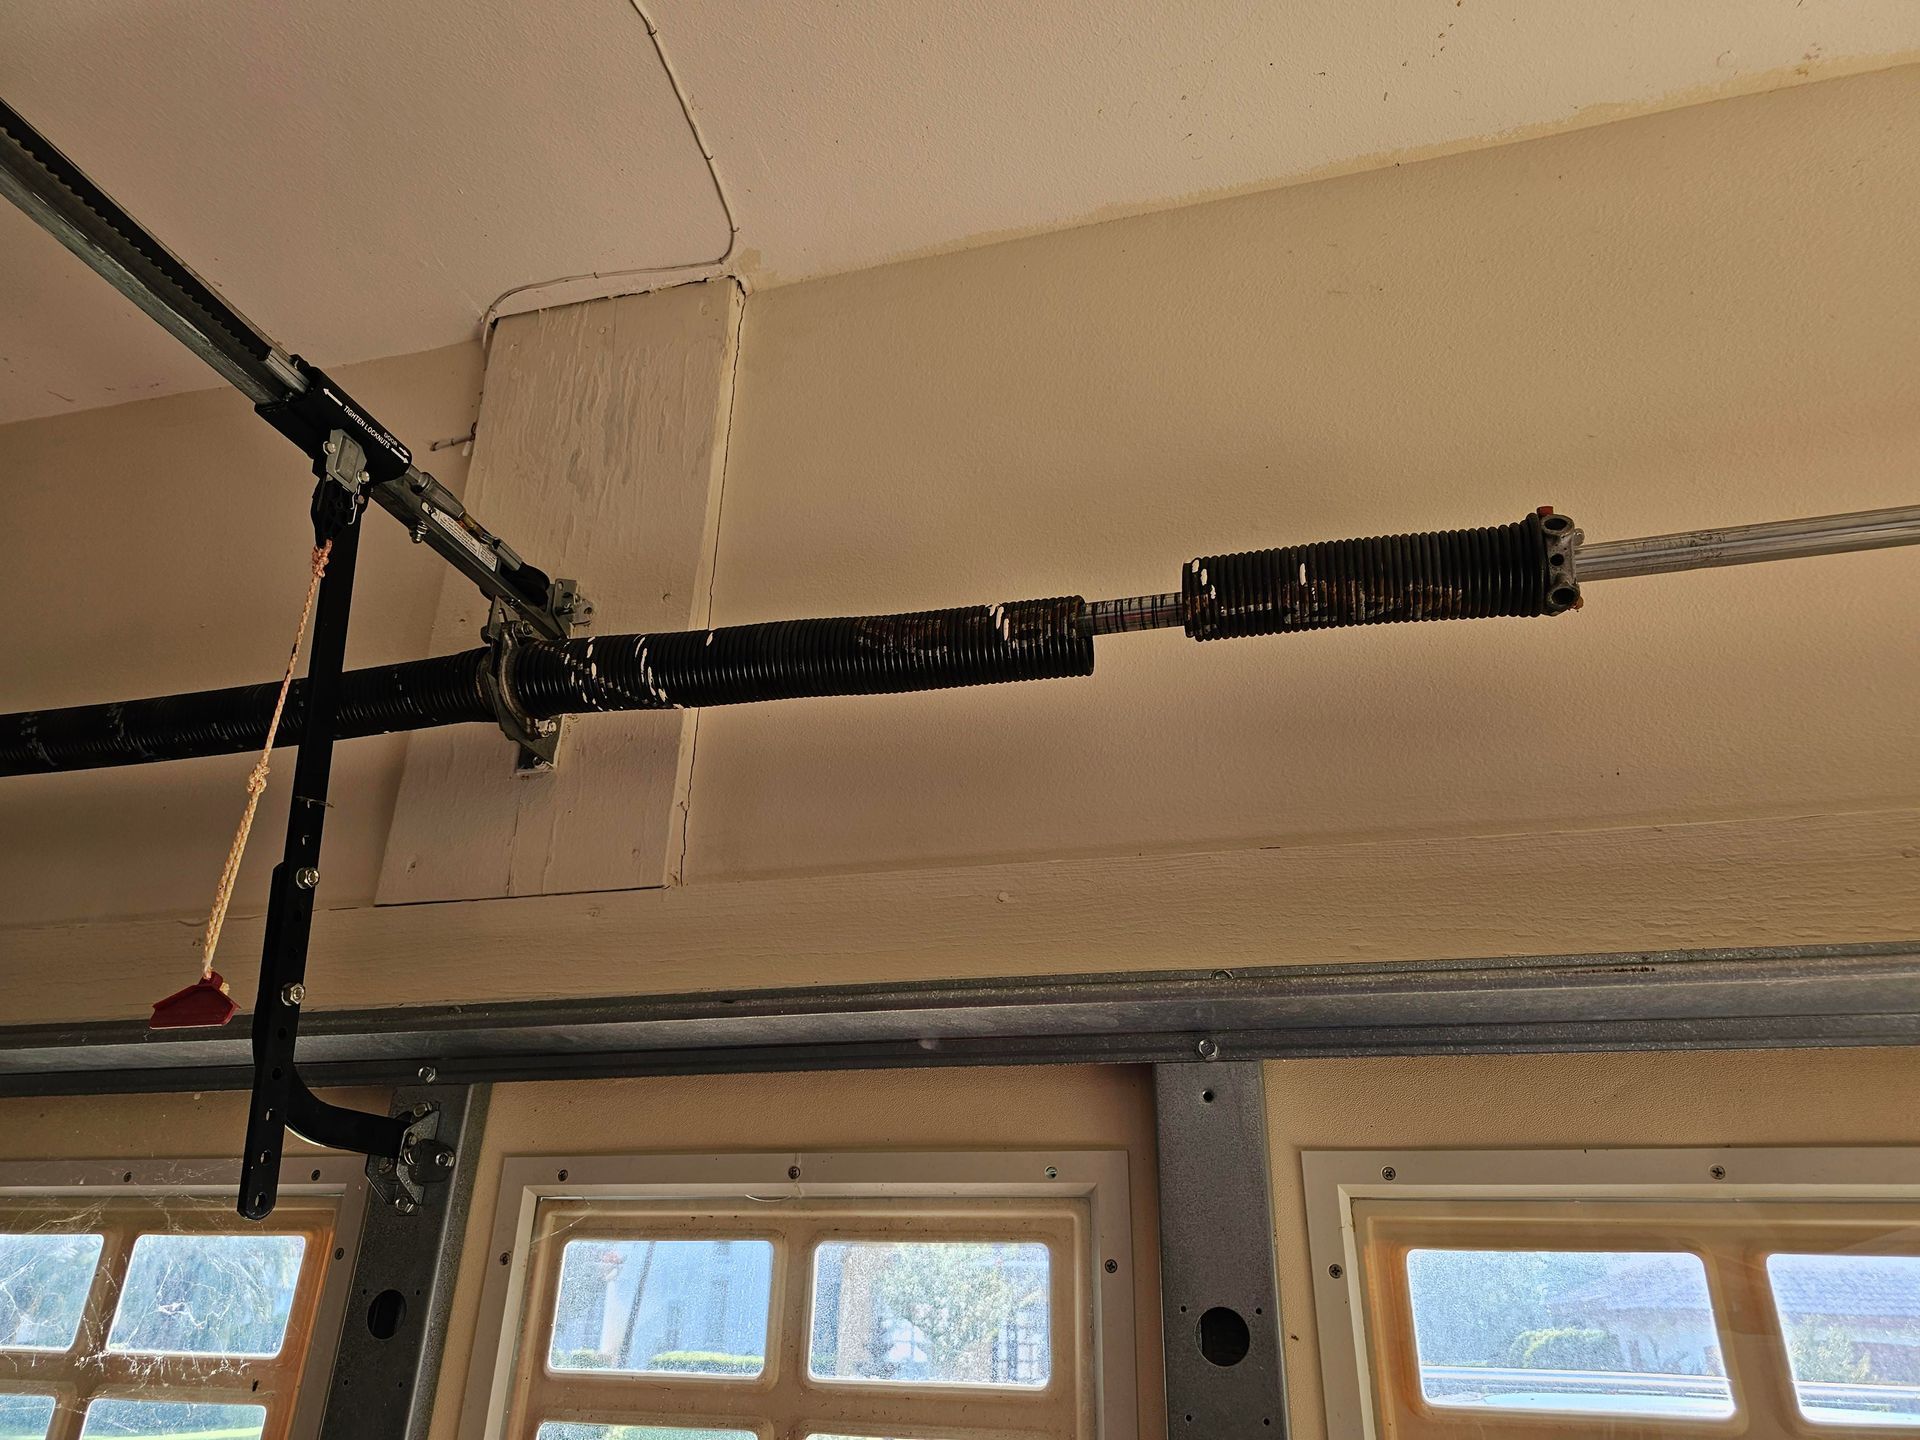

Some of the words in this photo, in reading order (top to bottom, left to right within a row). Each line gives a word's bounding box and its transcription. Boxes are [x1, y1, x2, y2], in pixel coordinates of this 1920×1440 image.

[343, 405, 365, 427] TIGHTEN
[364, 424, 390, 449] LOCKNUTS
[384, 432, 398, 447] DOOR
